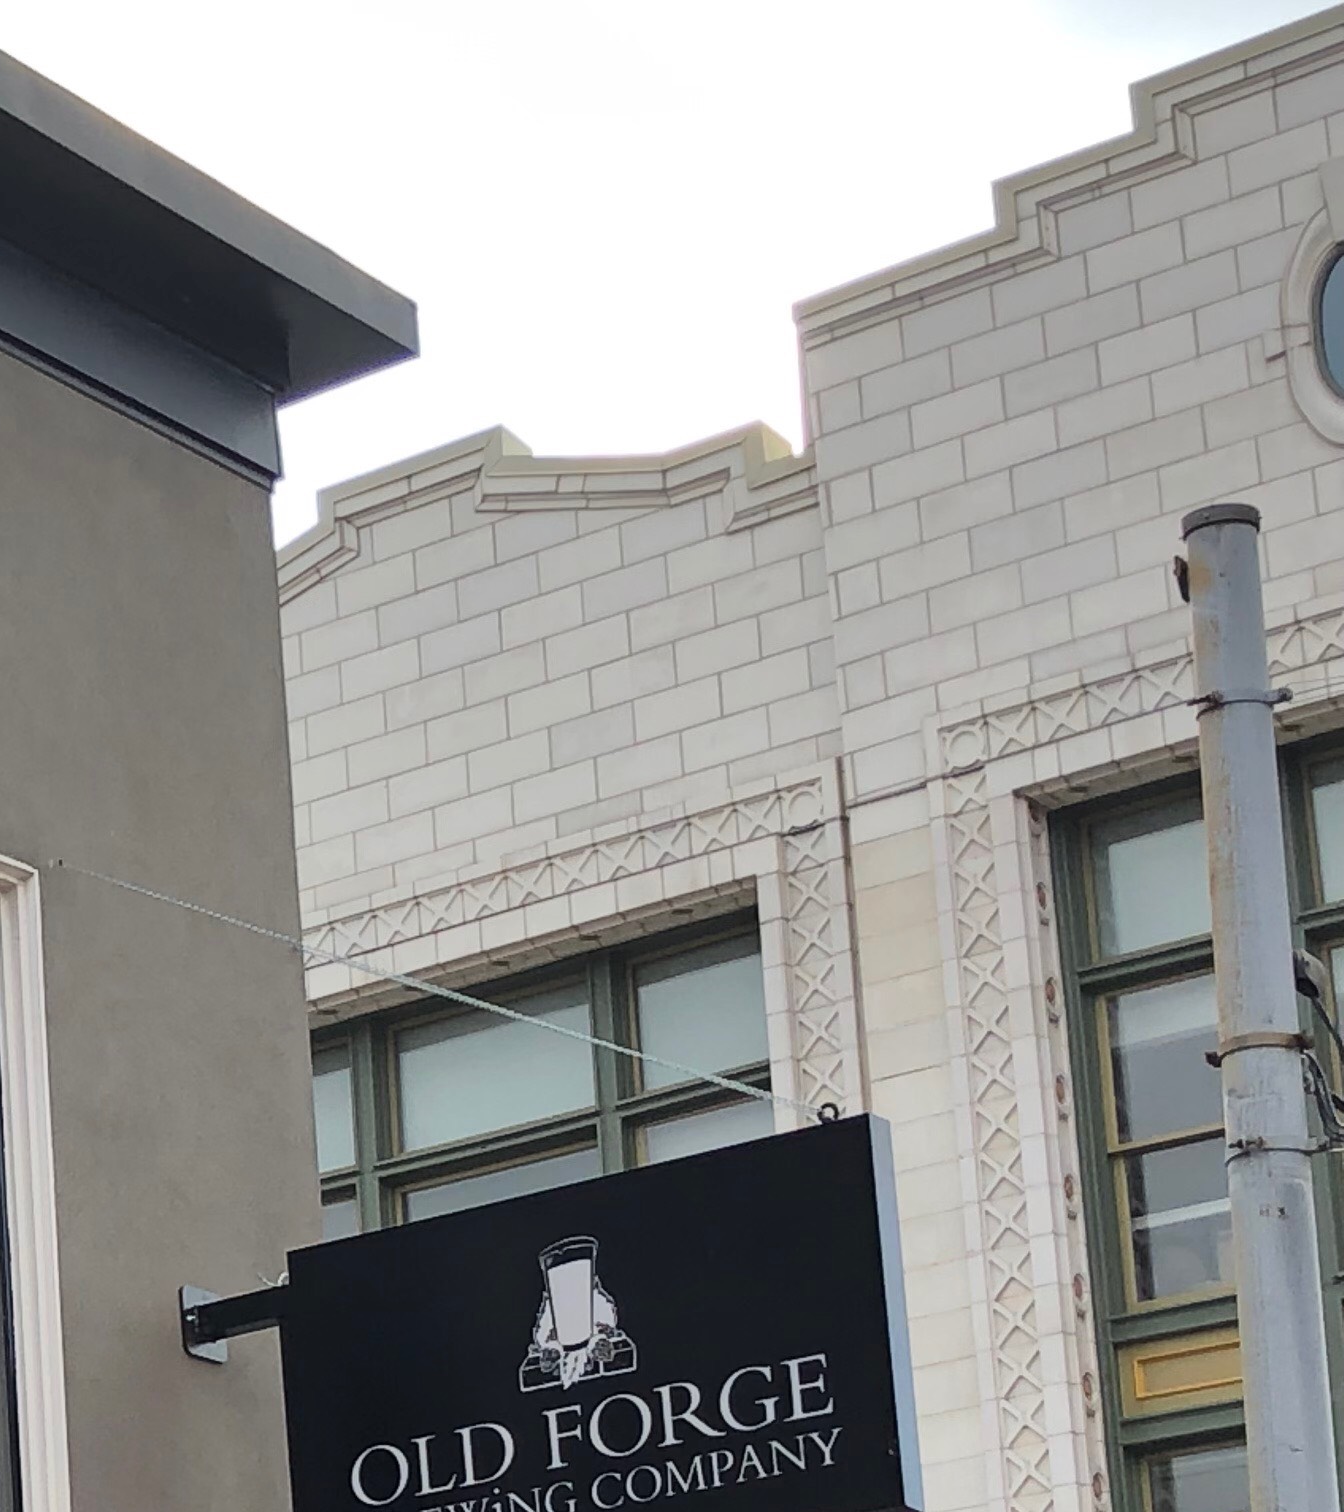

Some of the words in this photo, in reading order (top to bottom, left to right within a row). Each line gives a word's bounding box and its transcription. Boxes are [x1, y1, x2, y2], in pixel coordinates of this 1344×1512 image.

[349, 1422, 516, 1508] OLD
[543, 1353, 835, 1470] FORGE
[590, 1428, 844, 1510] COMPANY
